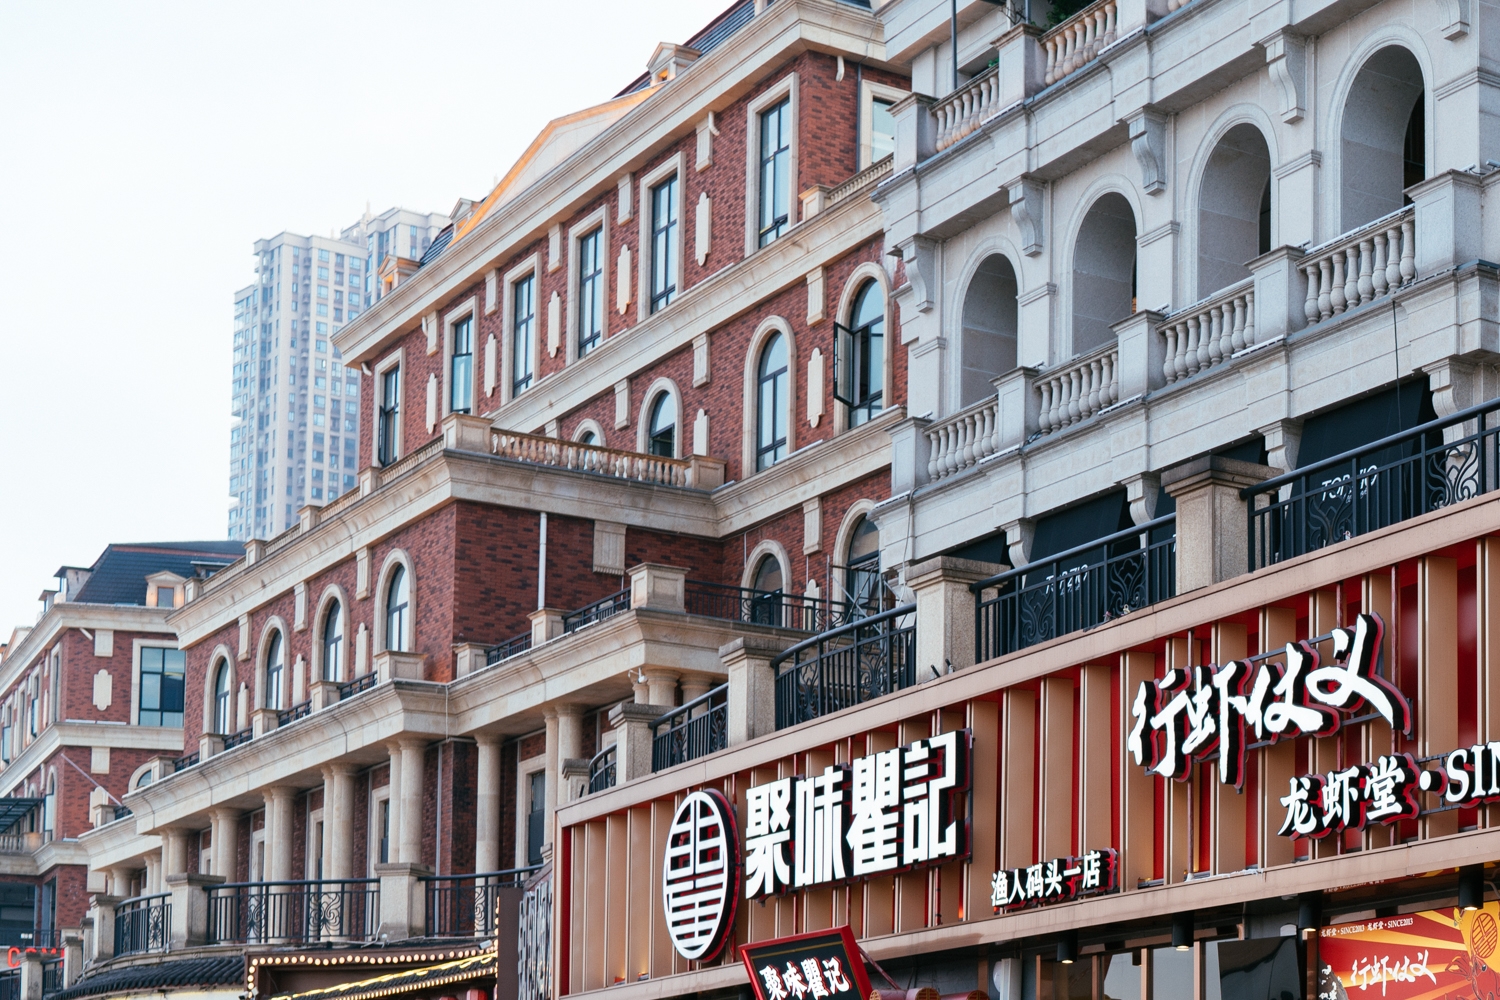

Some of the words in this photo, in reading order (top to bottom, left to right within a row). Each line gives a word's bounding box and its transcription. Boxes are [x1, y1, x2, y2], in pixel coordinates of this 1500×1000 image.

[1129, 627, 1397, 784] 行虾仗义
[745, 731, 957, 900] 聚味瞿記
[991, 849, 1101, 907] 渔人码头一店
[1350, 949, 1437, 997] 行虾仗义
